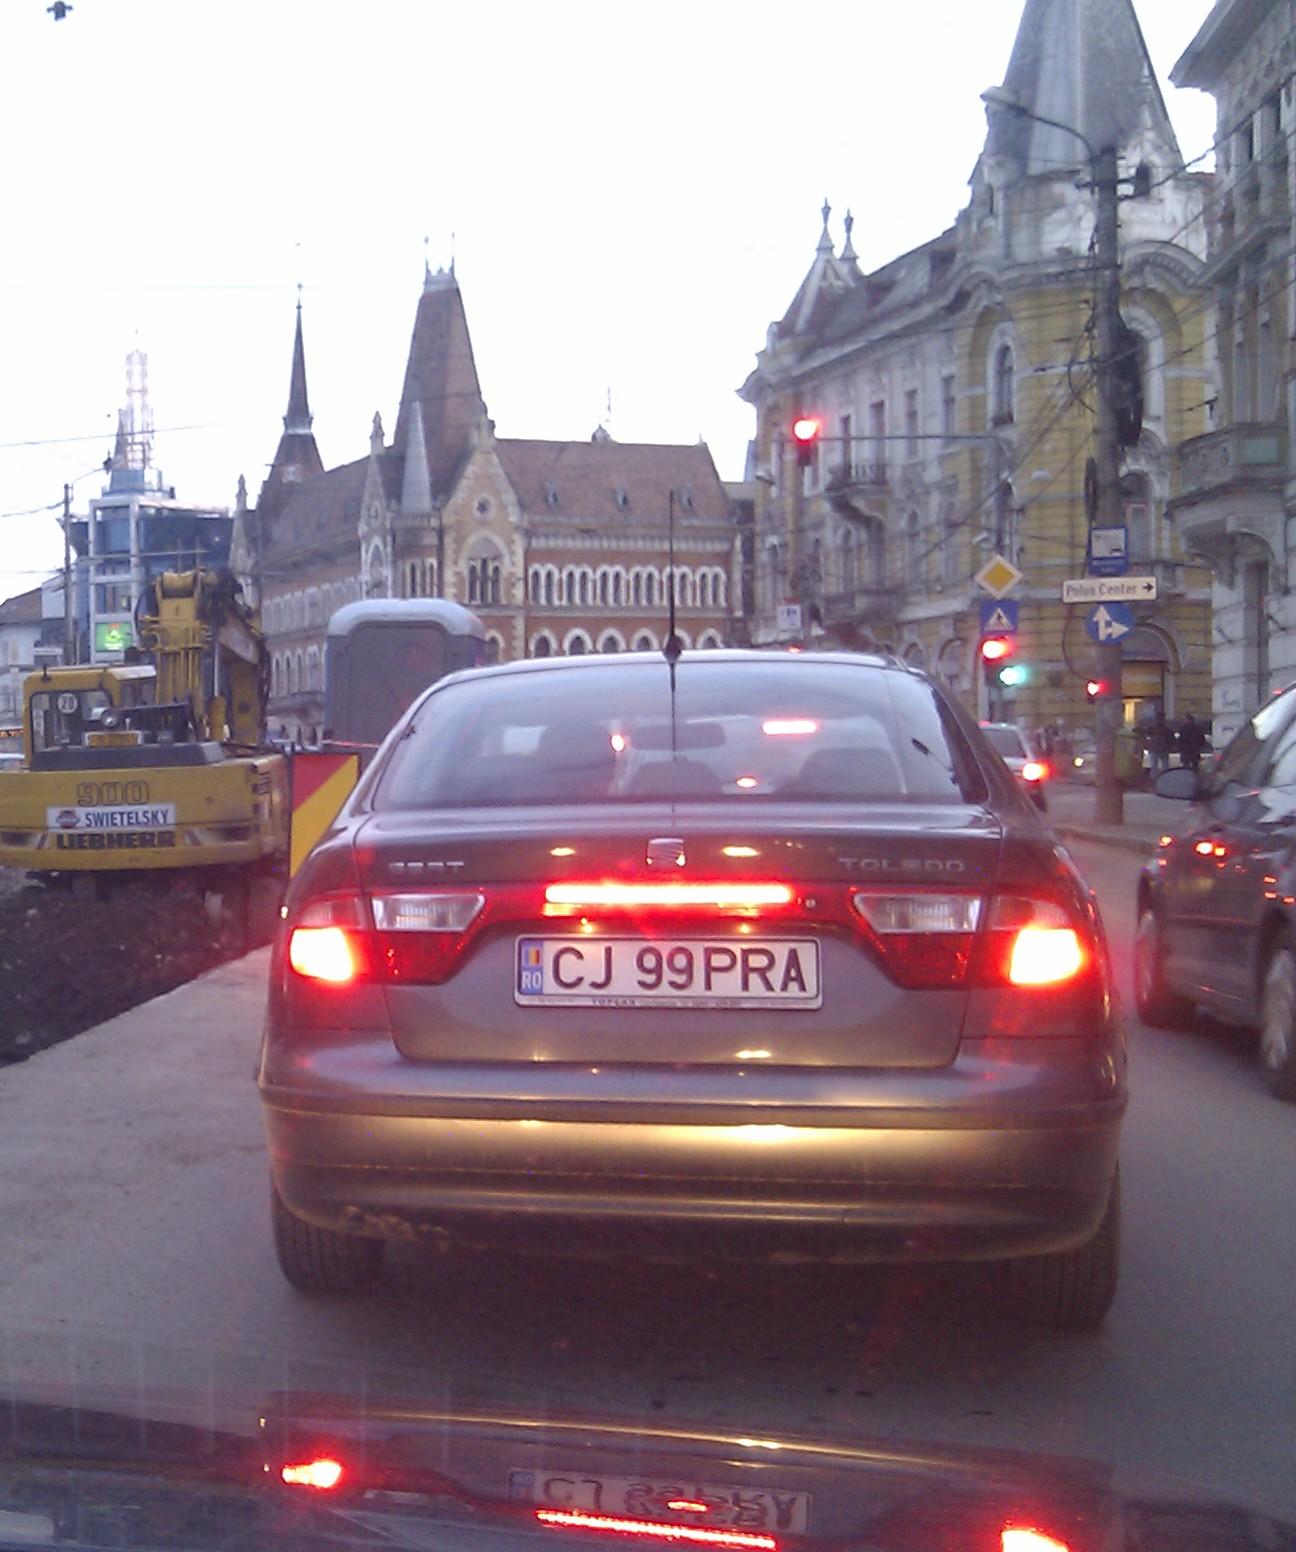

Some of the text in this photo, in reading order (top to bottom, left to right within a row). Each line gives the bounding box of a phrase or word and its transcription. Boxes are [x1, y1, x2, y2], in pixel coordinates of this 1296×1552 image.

[1098, 582, 1138, 596] Center
[76, 780, 150, 807] 900
[85, 809, 169, 828] SWIETELSKY
[56, 831, 176, 850] LIEBHERR
[838, 857, 967, 872] TOLEDO
[552, 945, 613, 990] CJ
[521, 971, 542, 989] RO
